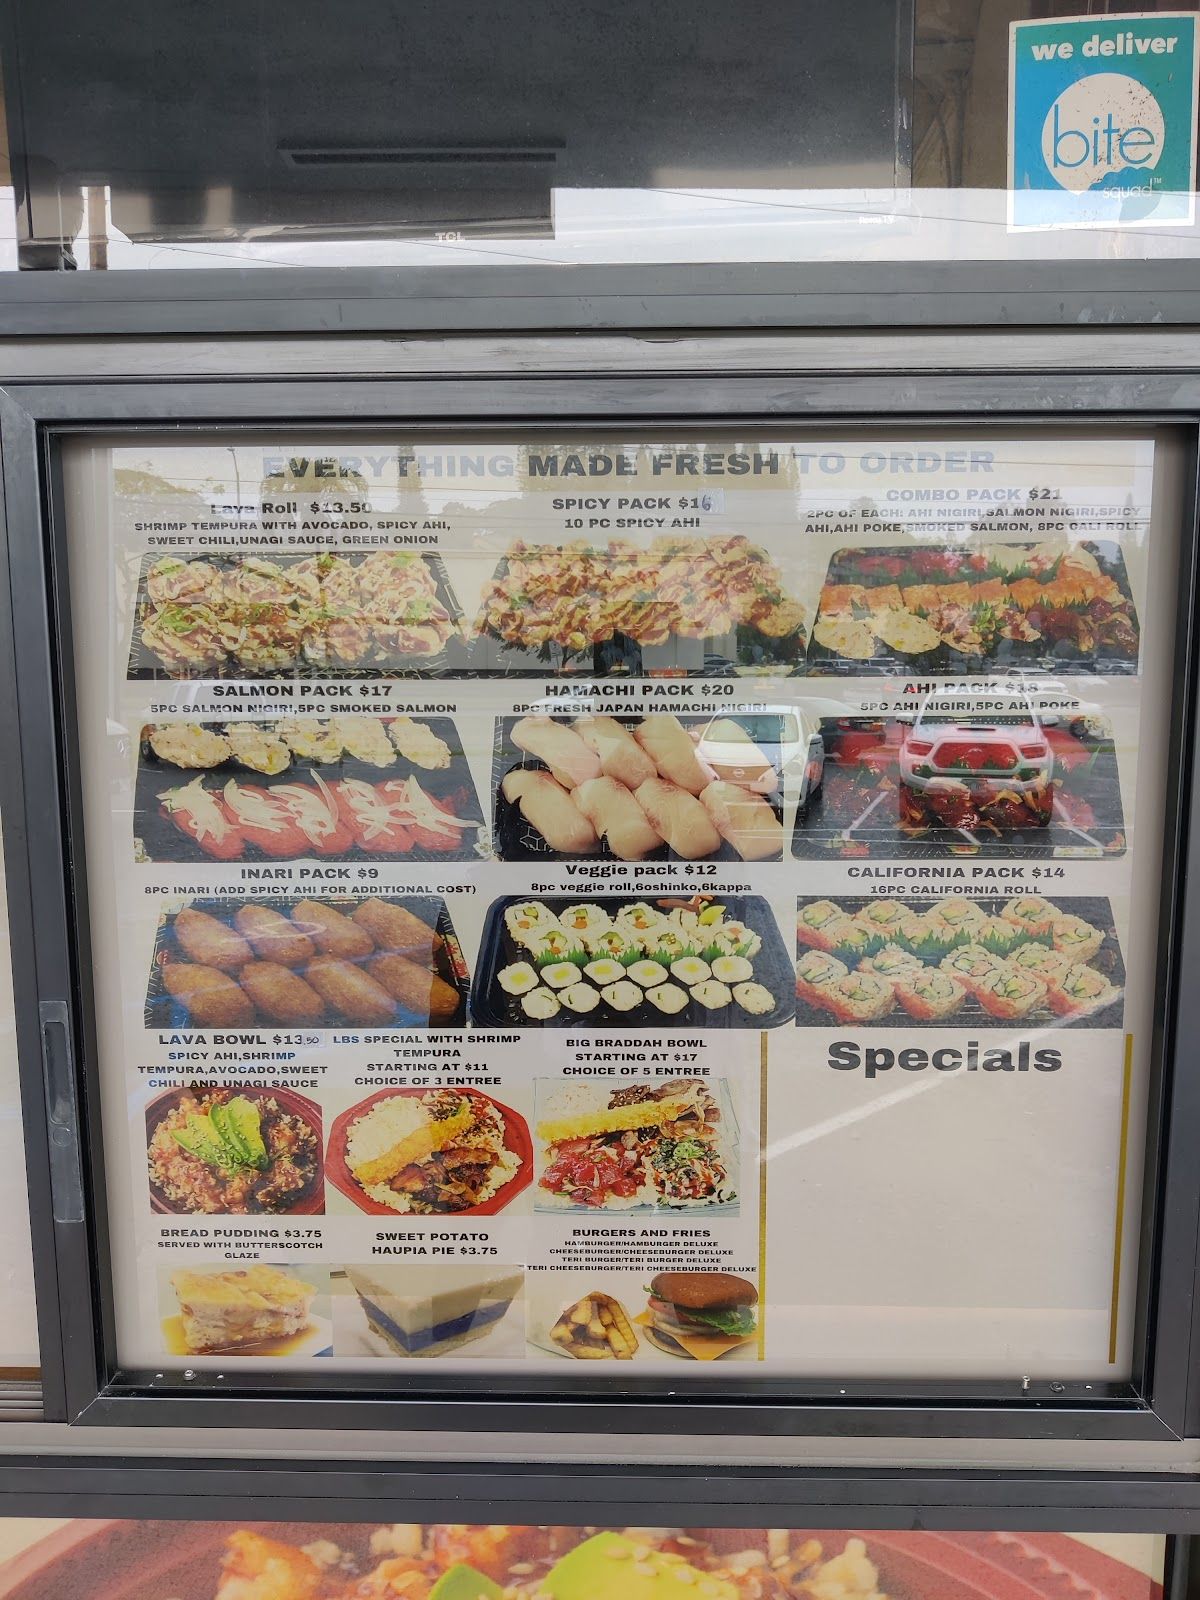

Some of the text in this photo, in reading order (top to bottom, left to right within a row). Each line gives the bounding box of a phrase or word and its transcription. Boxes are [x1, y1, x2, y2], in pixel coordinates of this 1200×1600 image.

[1031, 32, 1178, 61] we deliver
[1054, 104, 1155, 168] bite
[1103, 178, 1153, 202] squad
[435, 232, 465, 242] TCL
[263, 450, 996, 478] EVERYTHING MADE FRESH TO ORDER
[886, 488, 1063, 501] COMBO PACK $21
[262, 502, 297, 514] Roll
[310, 502, 372, 514] $13.50
[552, 498, 611, 510] SPICY
[618, 498, 671, 509] PACK
[807, 510, 833, 518] 2PC
[839, 510, 857, 518] OF
[861, 509, 903, 518] EACH:
[908, 509, 932, 517] AHI
[134, 521, 451, 531] SHRIMP TEMPURA WITH AVOCADO, SPICY AHI,
[564, 518, 700, 528] 10 PC SPICY AHI
[805, 524, 858, 534] AHI,AHI
[970, 523, 1033, 533] SALMON,
[1038, 522, 1064, 531] 8PC
[148, 535, 439, 546] SWEET CHILI,UNAGI SAUCE, GREEN ONION
[213, 685, 393, 697] SALMON PACK $17
[545, 684, 734, 696] HAMACHI PACK $20
[902, 683, 937, 693] AHI
[944, 683, 998, 693] PACK
[151, 704, 178, 713] 5PC
[182, 704, 243, 713] SALMON
[330, 704, 391, 712] SMOKED
[396, 704, 457, 712] SALMON
[512, 703, 768, 712] 8PC FRESH JAPAN HAMACHI NIGIRI
[861, 702, 888, 710] 5PC
[893, 702, 919, 710] AHI
[241, 868, 379, 879] INARI PACK $9
[565, 864, 717, 878] Veggie pack $12
[848, 867, 1065, 878] CALIFORNIA PACK $14
[144, 885, 476, 895] 8PC INARI (ADD SPICY AHI FOR ADDITIONAL COST)
[531, 883, 555, 893] 8pc
[560, 883, 604, 892] veggie
[871, 886, 1041, 894] 16PC CALIFORNIA ROLL
[159, 1035, 207, 1044] LAVA
[213, 1035, 266, 1044] BOWL
[467, 1035, 521, 1043] SHRIMP
[214, 1053, 296, 1061] AHI,SHRIMP
[674, 1053, 697, 1061] $17
[828, 1041, 1062, 1078] Specials
[465, 1063, 488, 1071] $11
[563, 1067, 615, 1075] CHOICE
[412, 1077, 430, 1085] OF
[435, 1077, 442, 1085] 3
[447, 1077, 502, 1085] ENTREE
[161, 1229, 209, 1237] BREAD
[284, 1229, 322, 1238] $3.75
[430, 1233, 489, 1241] POTATO
[572, 1229, 636, 1237] BURGERS
[460, 1246, 498, 1255] $3.75
